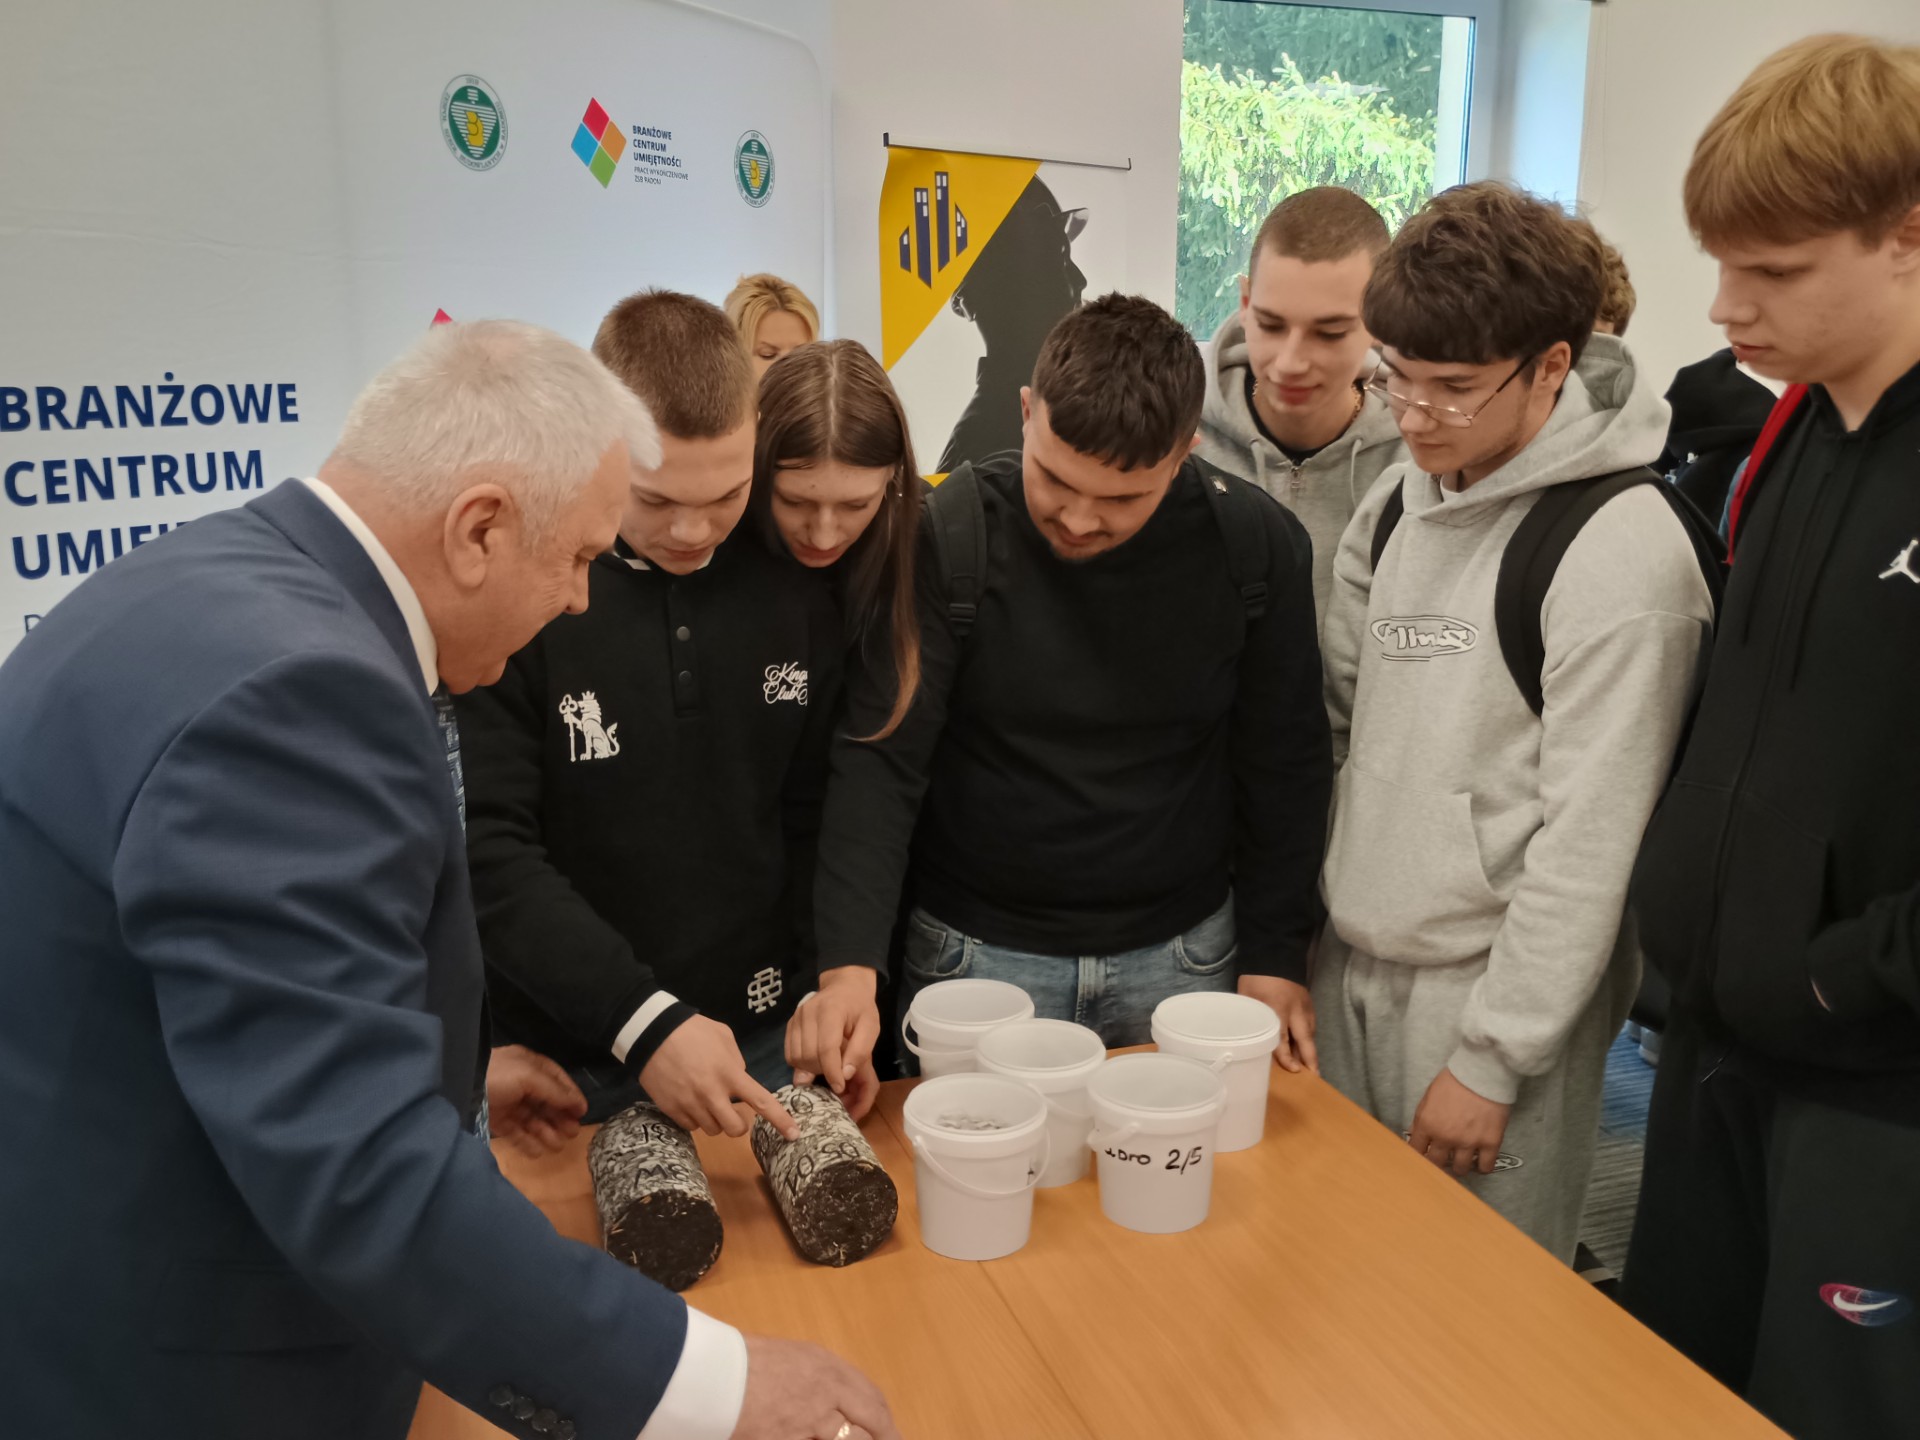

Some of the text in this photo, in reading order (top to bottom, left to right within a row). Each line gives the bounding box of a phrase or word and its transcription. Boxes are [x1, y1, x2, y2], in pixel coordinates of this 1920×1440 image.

[632, 125, 672, 141] BRANŻOWE
[633, 138, 667, 152] CENTRUM
[633, 152, 682, 168] UMIEJĘTNOŚCI
[0, 371, 299, 432] BRANŻOWE
[4, 449, 264, 507] CENTRUM
[1164, 1145, 1202, 1175] 2/5
